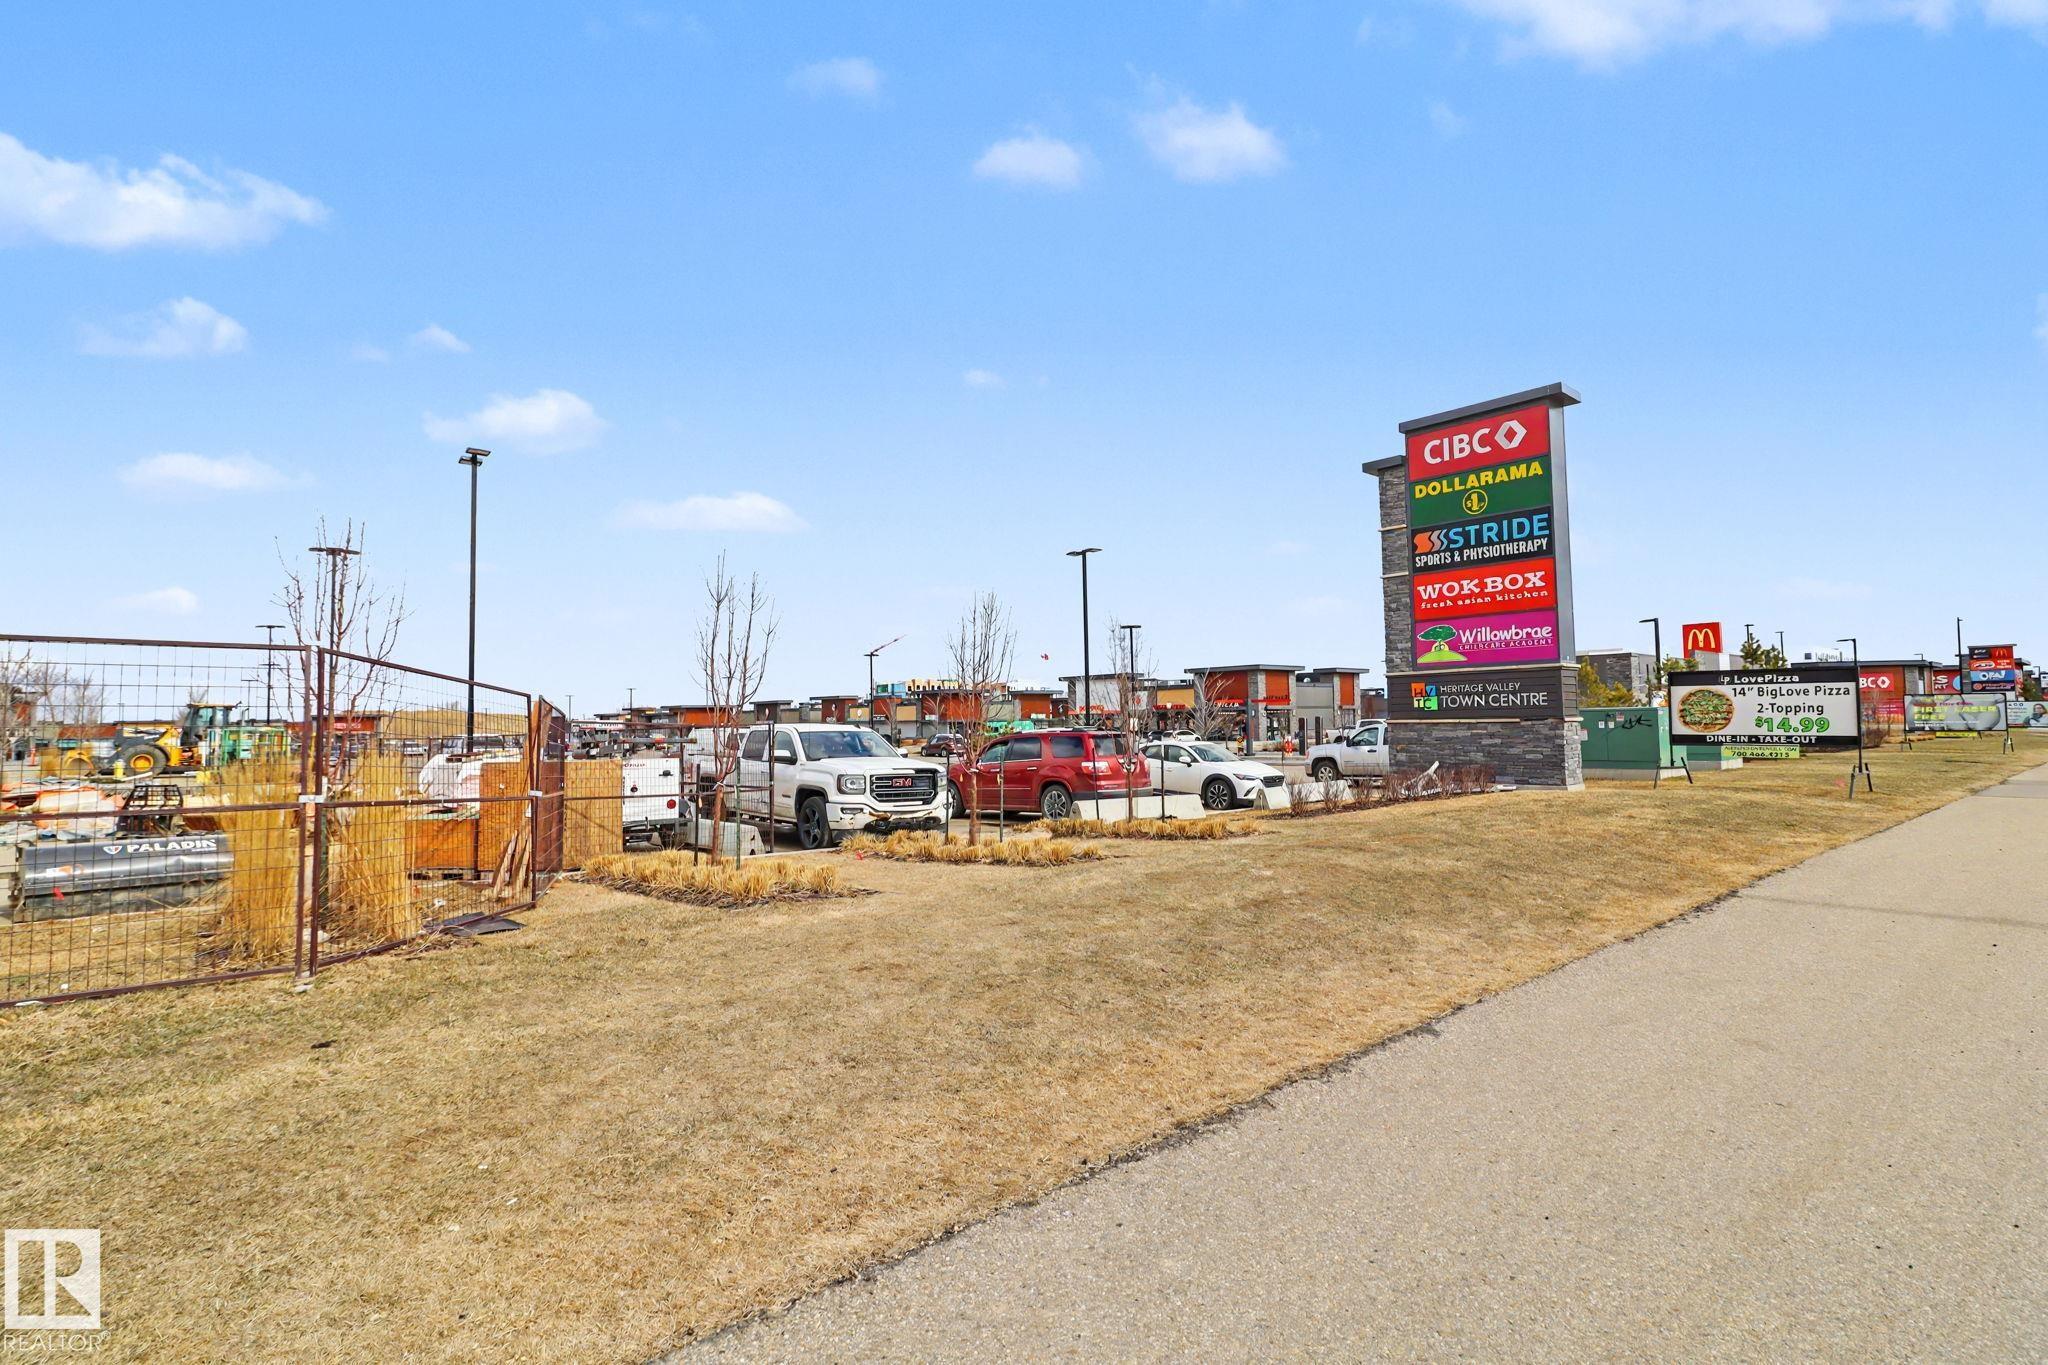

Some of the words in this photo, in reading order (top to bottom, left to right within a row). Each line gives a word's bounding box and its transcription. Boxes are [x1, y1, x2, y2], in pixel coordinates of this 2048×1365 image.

[1423, 427, 1492, 465] CIBC
[1414, 460, 1544, 499] DOLLARAMA
[1448, 513, 1550, 549] STRIDE
[1415, 552, 1452, 567] SPORTS
[1454, 551, 1461, 563] &
[1463, 537, 1548, 561] PHYSIOTHERAPY
[1417, 579, 1481, 600] WOK
[1484, 571, 1546, 593] BOX
[1421, 600, 1454, 609] fresh
[1496, 590, 1549, 602] kitchen
[1458, 625, 1553, 644] Willowbrae
[1440, 683, 1483, 693] HERITAGE
[1486, 682, 1521, 692] VALLEY
[1859, 677, 1876, 688] BC
[1440, 695, 1486, 708] TOWN
[1489, 692, 1548, 707] CENTRE
[1757, 686, 1810, 699] BigLove
[1814, 685, 1851, 696] Pizza
[1757, 703, 1824, 715] 2-Topping
[1755, 716, 1831, 733] $14.99
[1706, 735, 1749, 743] DINE-IN
[1760, 736, 1818, 744] TAKE-OUT
[127, 839, 217, 853] PALADIN
